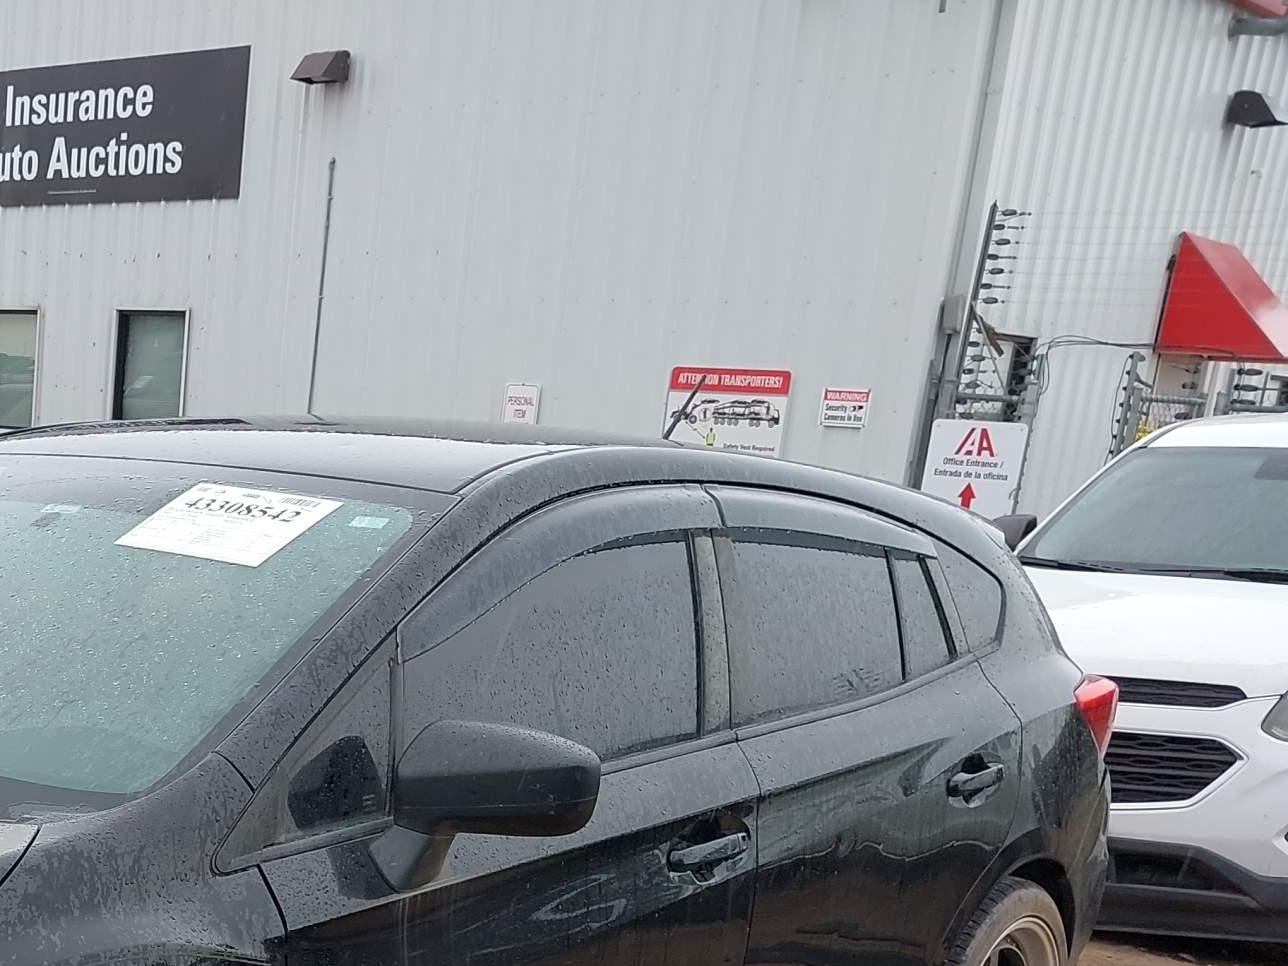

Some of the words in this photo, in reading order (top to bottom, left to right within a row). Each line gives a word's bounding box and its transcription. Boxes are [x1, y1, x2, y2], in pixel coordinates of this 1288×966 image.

[5, 83, 154, 127] Insurance
[46, 133, 183, 179] Auctions
[720, 375, 783, 388] TRANSPORTERS!
[826, 391, 867, 401] WARNING
[943, 457, 964, 466] Office
[966, 459, 999, 468] Entrance
[934, 468, 962, 478] Entrada
[963, 470, 973, 479] de
[974, 471, 981, 479] la
[983, 472, 1008, 481] oficina
[185, 497, 302, 523] 43308542
